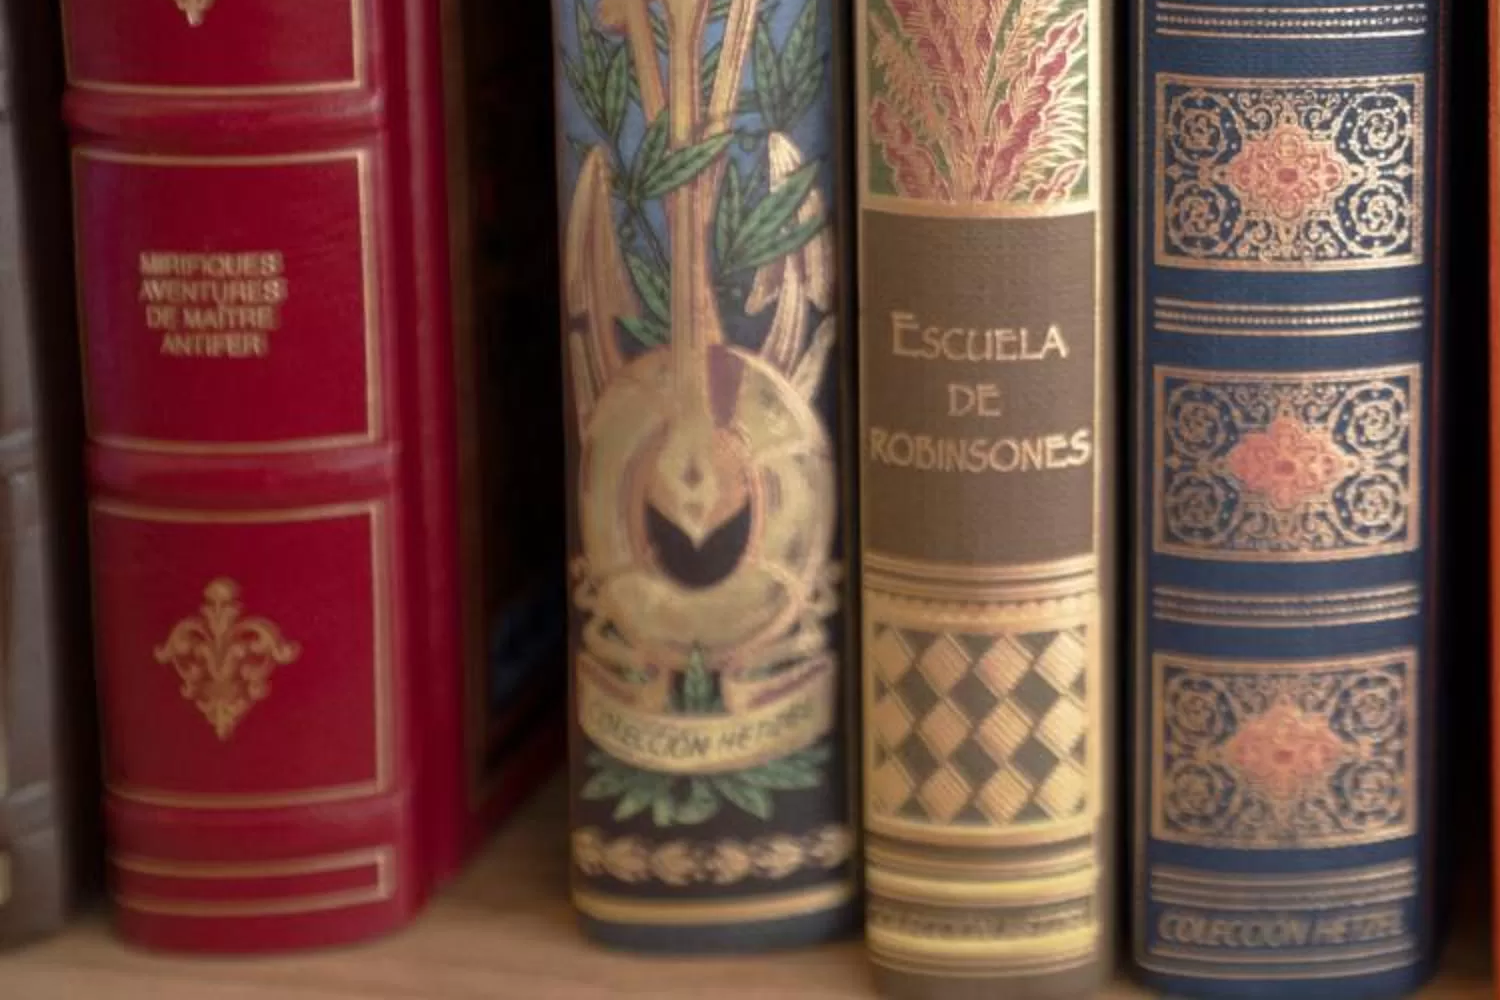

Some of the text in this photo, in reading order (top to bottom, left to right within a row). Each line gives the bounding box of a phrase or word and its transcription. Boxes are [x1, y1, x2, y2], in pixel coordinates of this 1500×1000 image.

[141, 278, 287, 302] AVENTURES
[147, 305, 176, 329] DE
[160, 332, 268, 356] ANTIFER
[891, 311, 1070, 361] ESCUELA
[948, 383, 1002, 417] DE
[870, 427, 1092, 474] ROBINSONES
